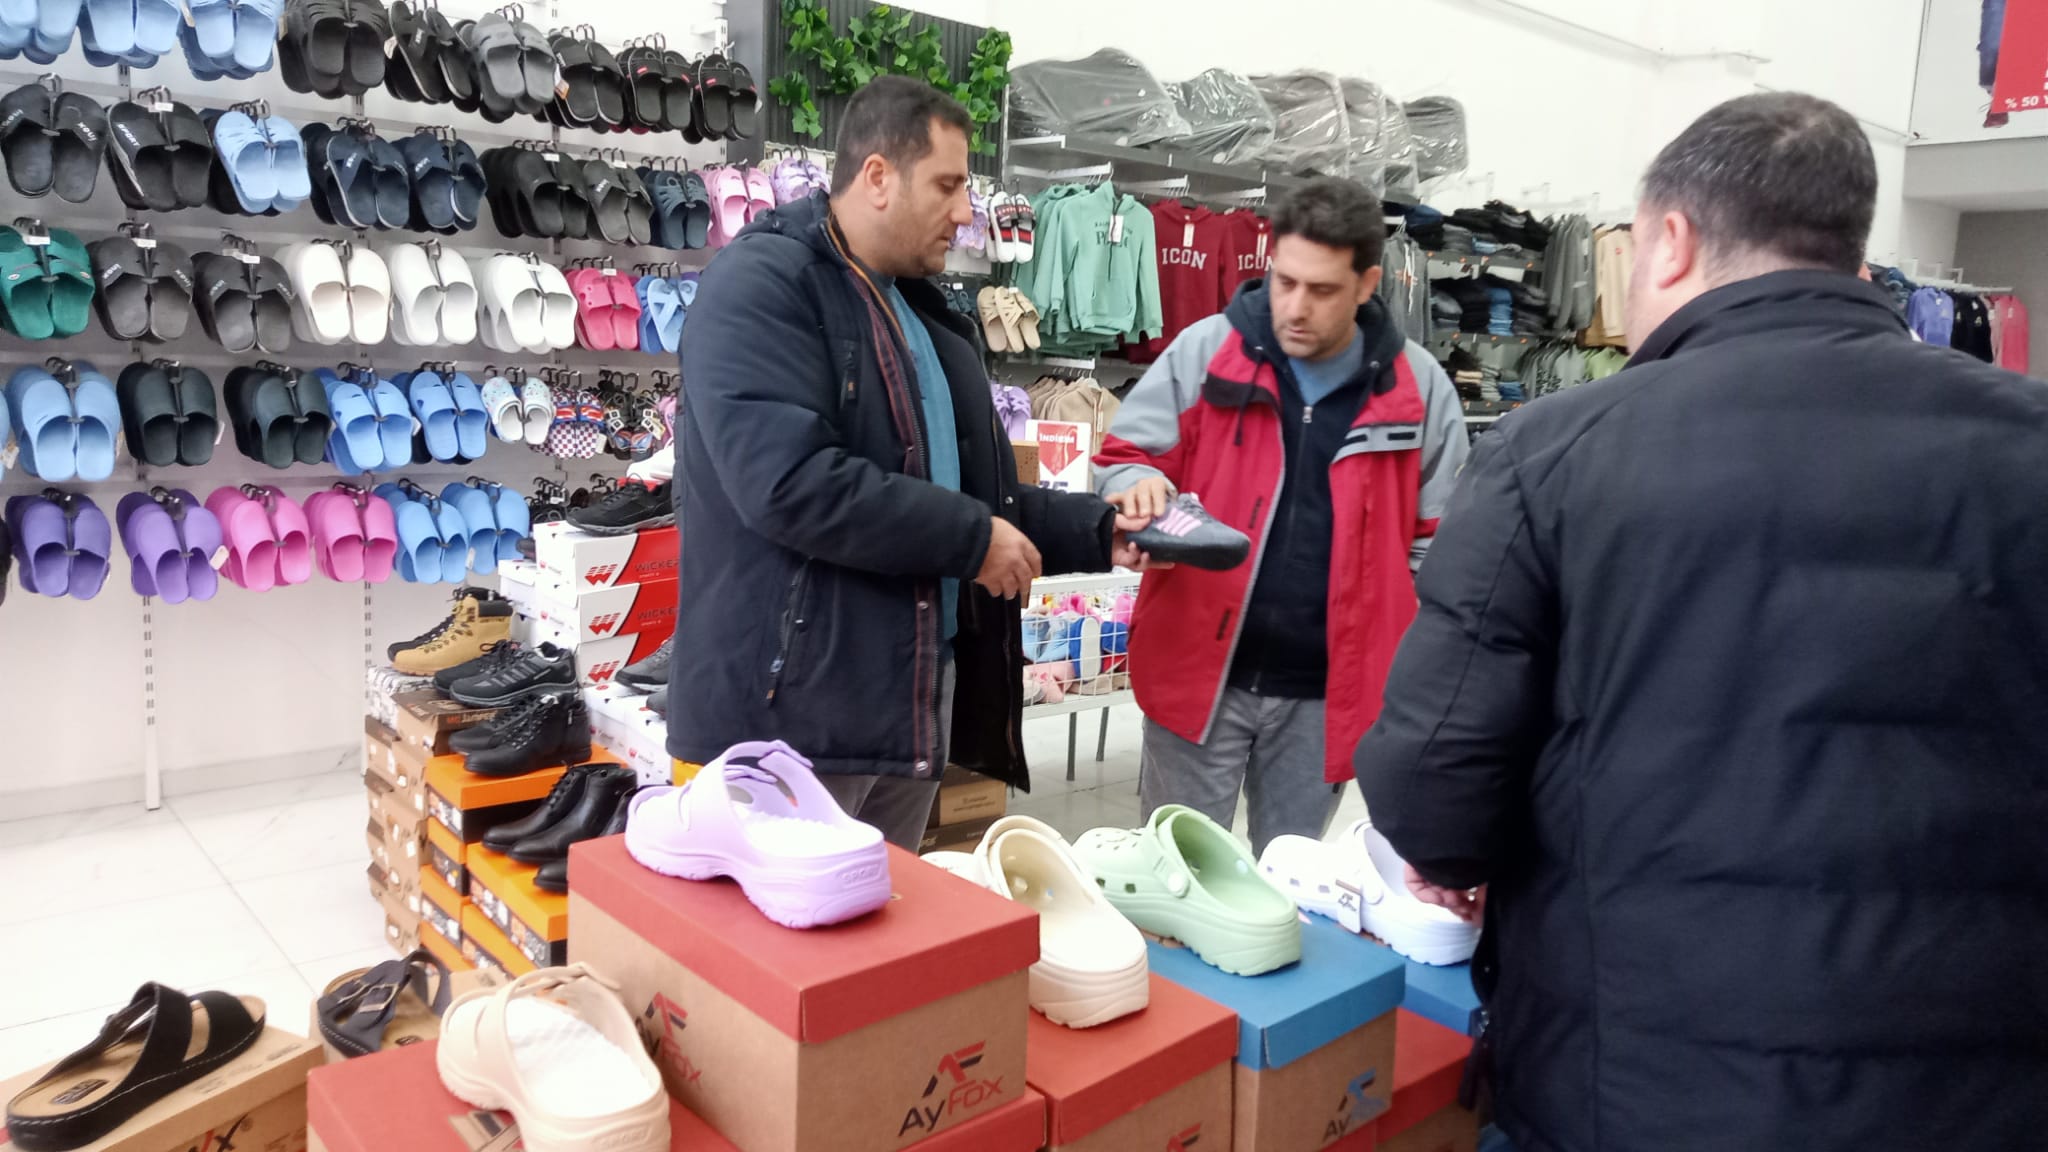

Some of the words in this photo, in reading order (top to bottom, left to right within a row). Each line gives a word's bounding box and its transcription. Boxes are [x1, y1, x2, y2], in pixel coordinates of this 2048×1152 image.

[2021, 95, 2039, 107] 50
[116, 123, 140, 147] SPORT
[1161, 247, 1207, 271] ICON
[898, 1075, 1004, 1137] AyFox
